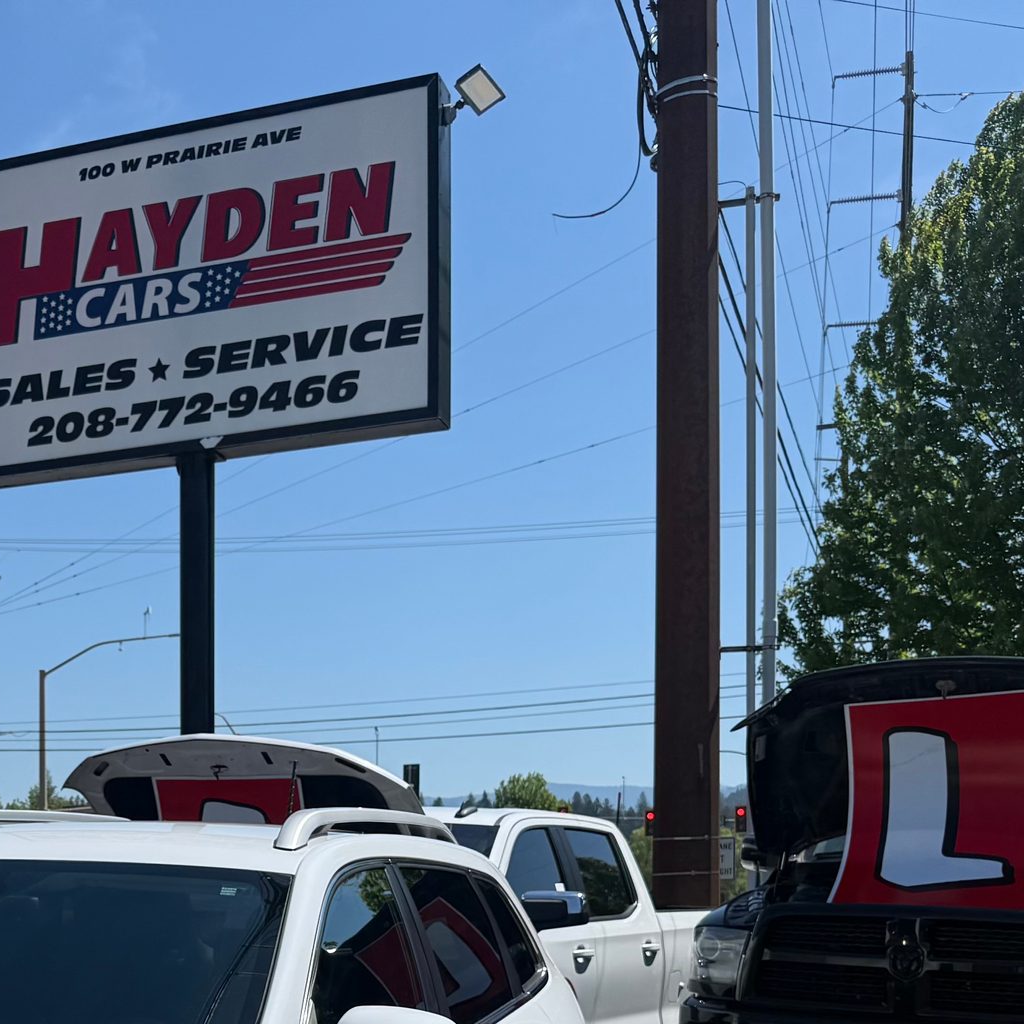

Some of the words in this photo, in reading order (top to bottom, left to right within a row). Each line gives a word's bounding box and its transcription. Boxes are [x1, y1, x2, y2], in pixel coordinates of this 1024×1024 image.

[79, 163, 115, 182] 100
[121, 159, 142, 174] W
[145, 136, 248, 170] PRAIRIE
[251, 125, 303, 150] AVE
[75, 271, 205, 329] CARS
[182, 313, 425, 379] SERVICE
[27, 370, 362, 448] 208-772-9466
